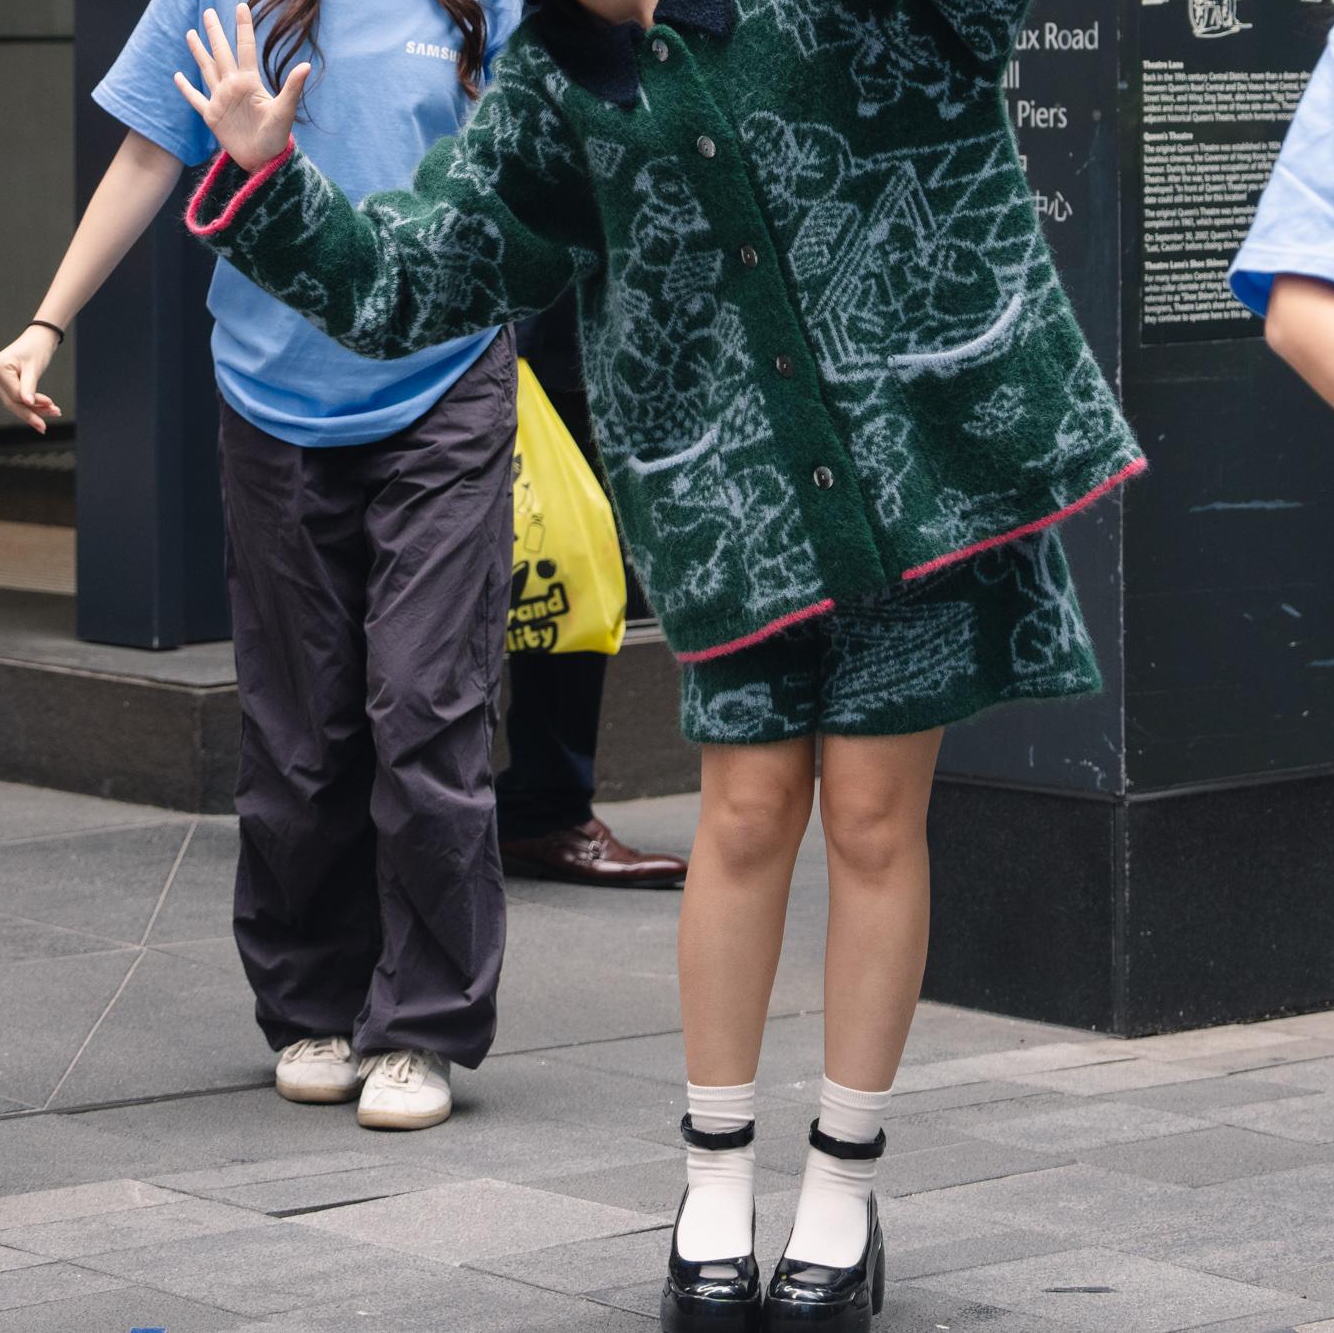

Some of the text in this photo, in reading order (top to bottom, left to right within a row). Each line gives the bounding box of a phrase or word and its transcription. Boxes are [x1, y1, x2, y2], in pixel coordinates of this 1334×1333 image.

[1015, 21, 1099, 50] ux Road
[406, 41, 460, 62] SAMSU
[1017, 100, 1067, 128] Piers
[507, 587, 565, 626] rand
[507, 625, 553, 651] lity
